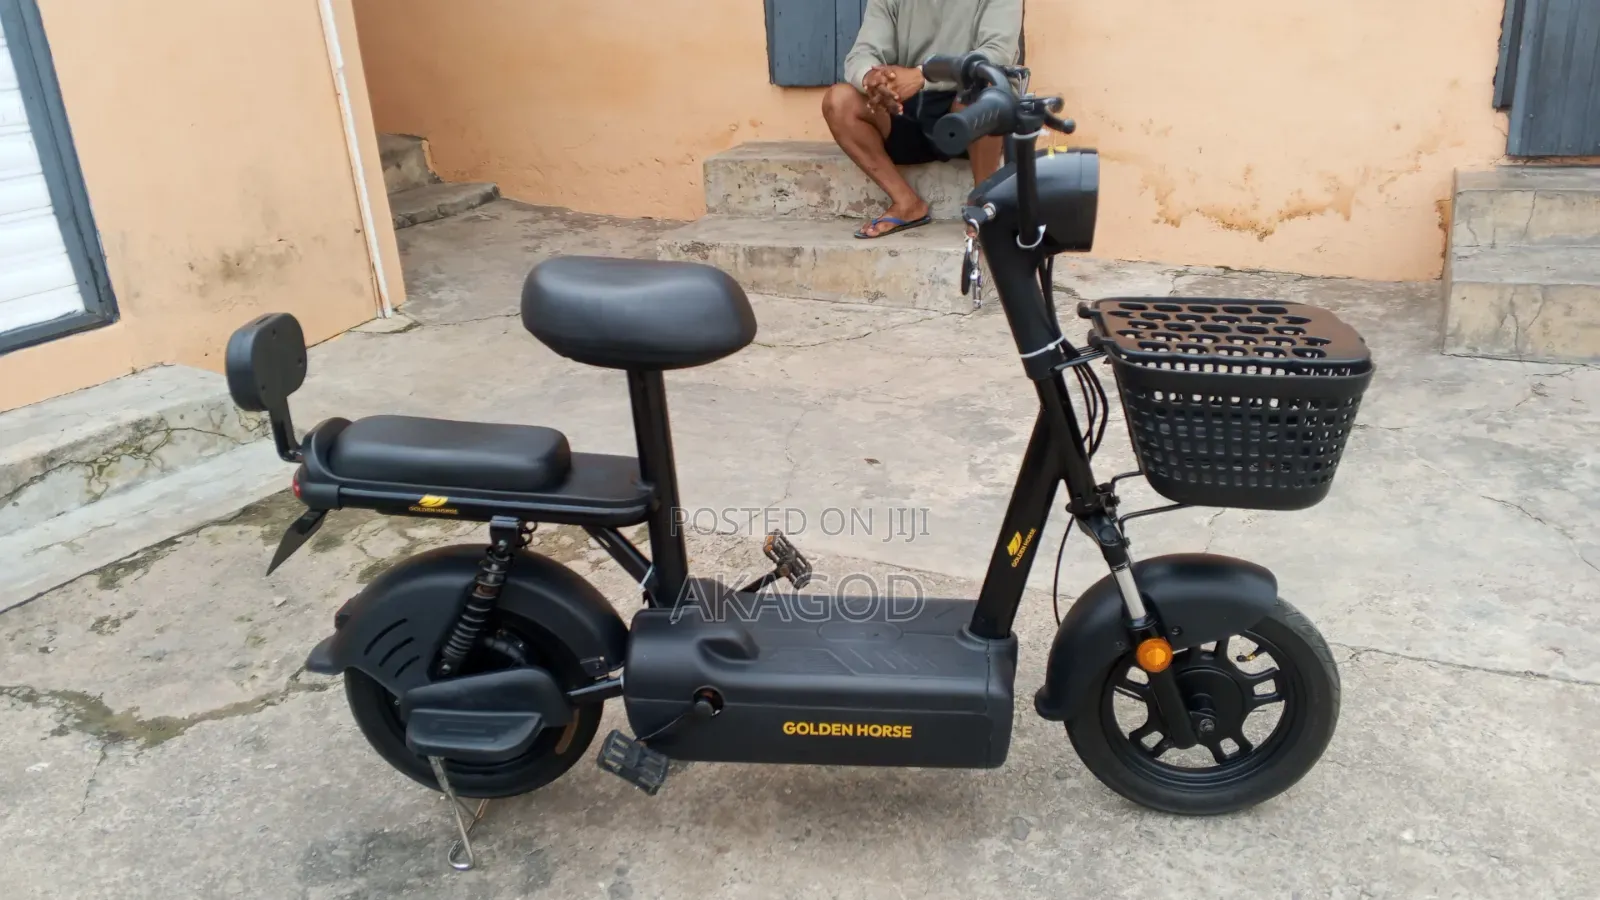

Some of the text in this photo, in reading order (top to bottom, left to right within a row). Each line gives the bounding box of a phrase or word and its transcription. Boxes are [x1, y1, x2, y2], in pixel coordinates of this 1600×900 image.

[408, 505, 435, 513] GOLDEN
[1011, 545, 1028, 567] GOLDEN
[782, 721, 913, 738] GOLDEN HORSE
